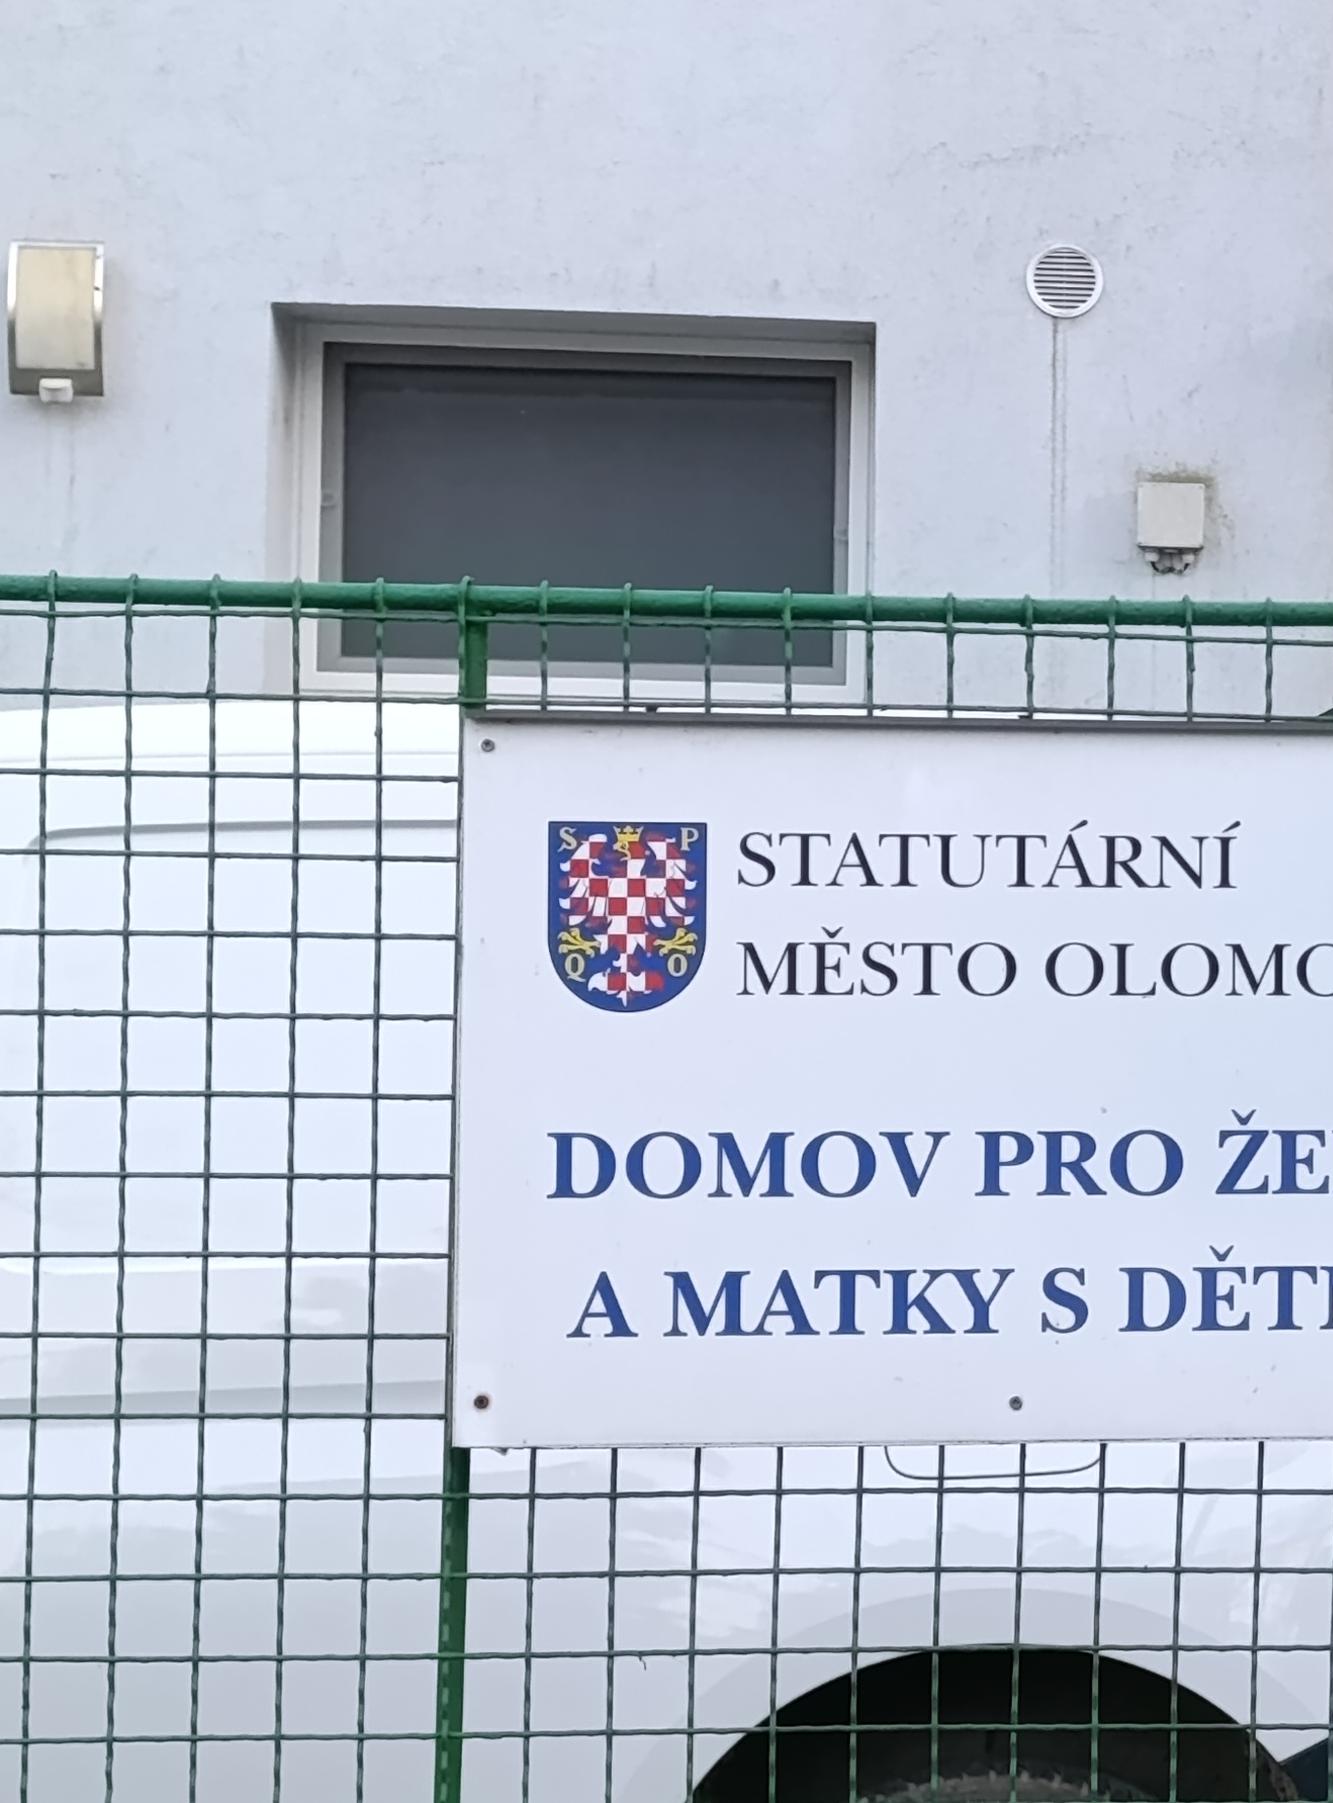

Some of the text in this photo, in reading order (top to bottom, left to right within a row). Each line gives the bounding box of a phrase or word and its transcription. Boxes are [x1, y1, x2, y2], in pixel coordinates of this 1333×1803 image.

[557, 826, 699, 852] S P
[737, 819, 1241, 890] STATUTÁRNÍ
[564, 953, 688, 982] Q O
[736, 926, 1017, 997] MĚSTO
[547, 1130, 951, 1200] DOMOV
[974, 1129, 1184, 1198] PRO
[566, 1271, 639, 1339] A
[663, 1268, 1015, 1337] MATKY
[1041, 1267, 1089, 1334] S
